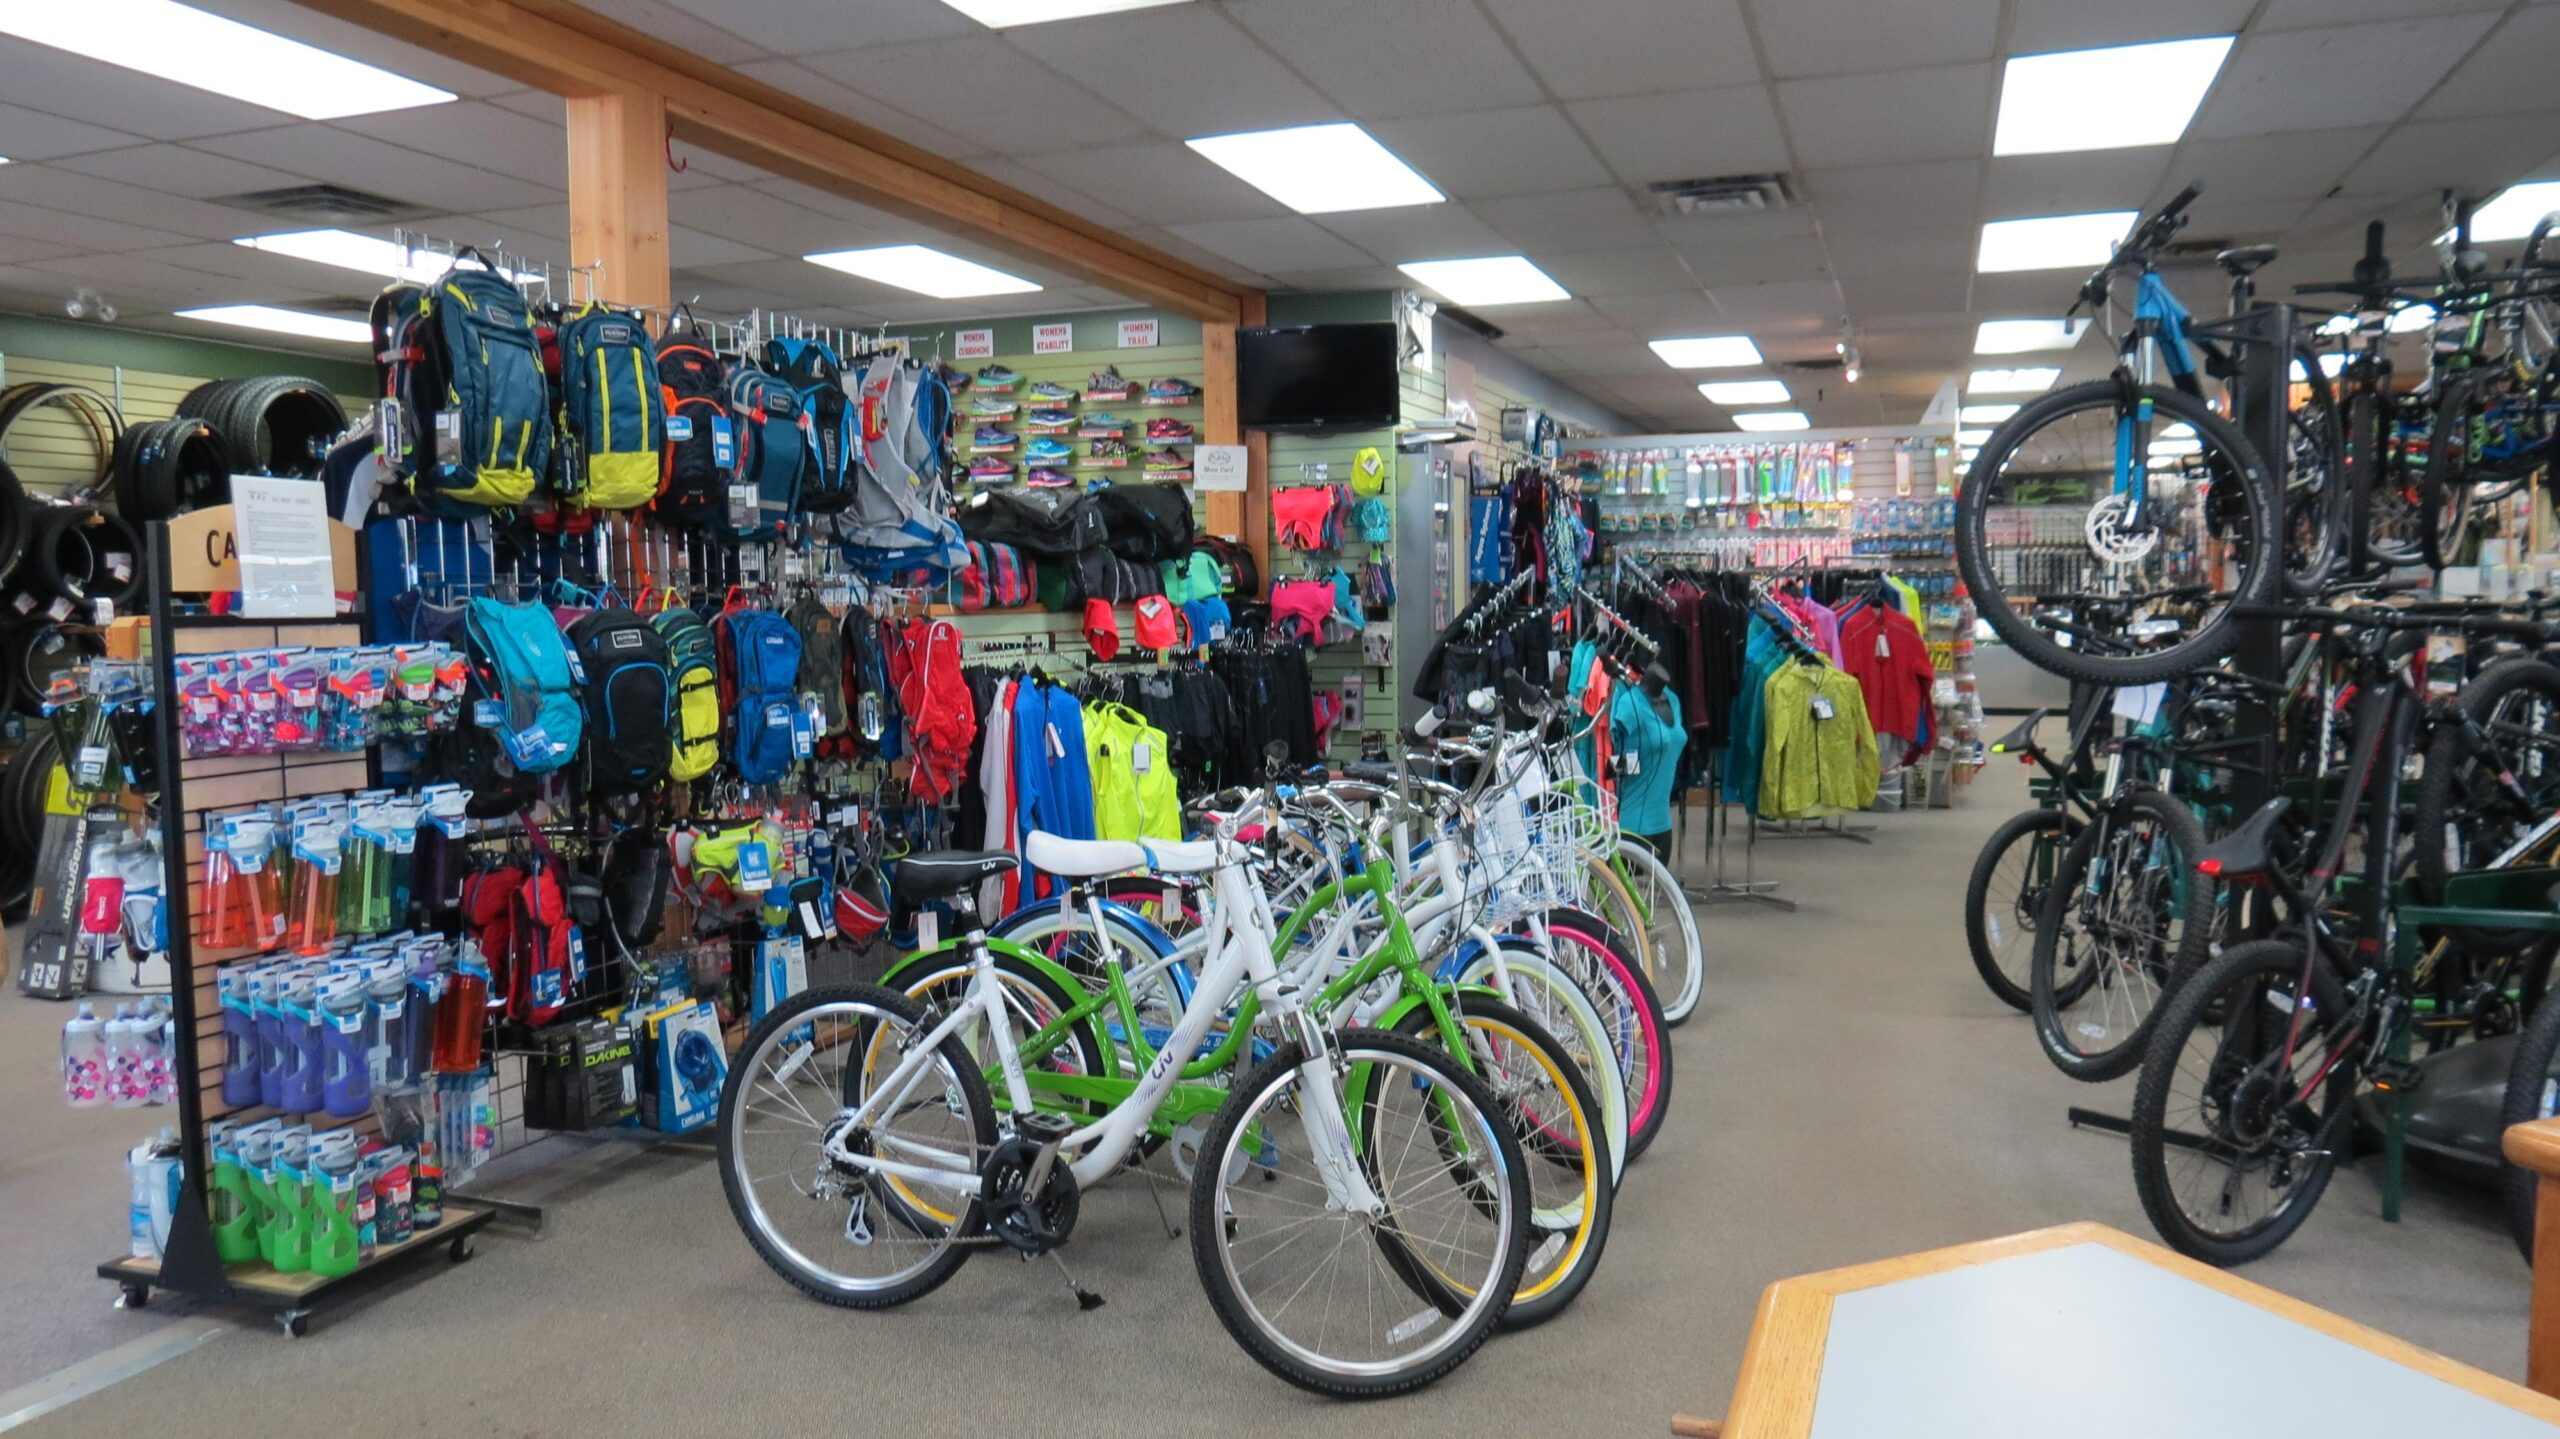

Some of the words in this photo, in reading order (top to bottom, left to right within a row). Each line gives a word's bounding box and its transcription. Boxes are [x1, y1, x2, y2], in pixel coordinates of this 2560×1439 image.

[1039, 326, 1067, 337] WOMENS
[1123, 322, 1154, 333] WOMENS
[963, 333, 986, 342] WOMENS
[1127, 336, 1150, 346] TRAIL
[1036, 339, 1069, 351] STABILITY
[62, 818, 87, 920] swagman
[584, 1044, 632, 1068] DAKINE
